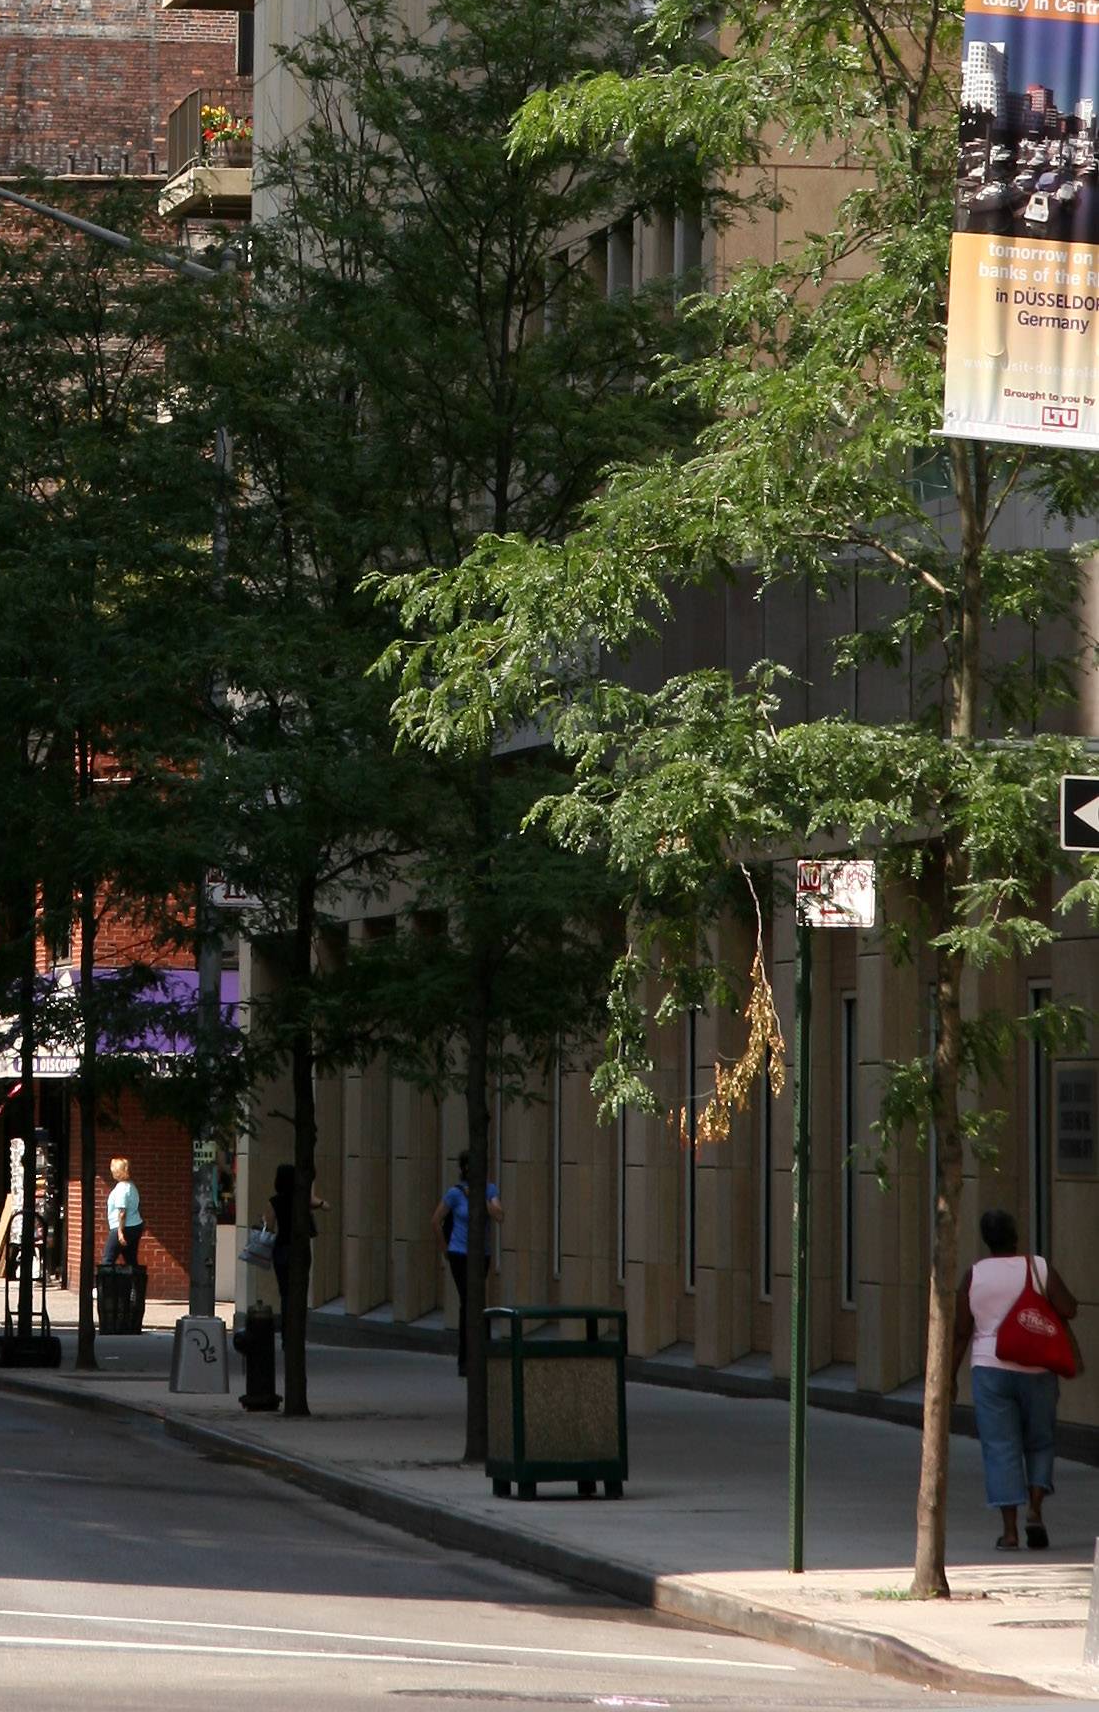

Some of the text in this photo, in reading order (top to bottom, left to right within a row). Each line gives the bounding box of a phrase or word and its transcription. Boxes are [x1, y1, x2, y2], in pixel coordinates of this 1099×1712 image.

[988, 242, 1093, 266] tomorrow on
[978, 263, 1028, 282] banks
[1033, 267, 1050, 283] of
[1055, 269, 1081, 286] the
[995, 287, 1008, 304] in
[1018, 310, 1089, 334] Germany
[1003, 387, 1095, 406] Brought to you by
[1043, 408, 1077, 427] LTU
